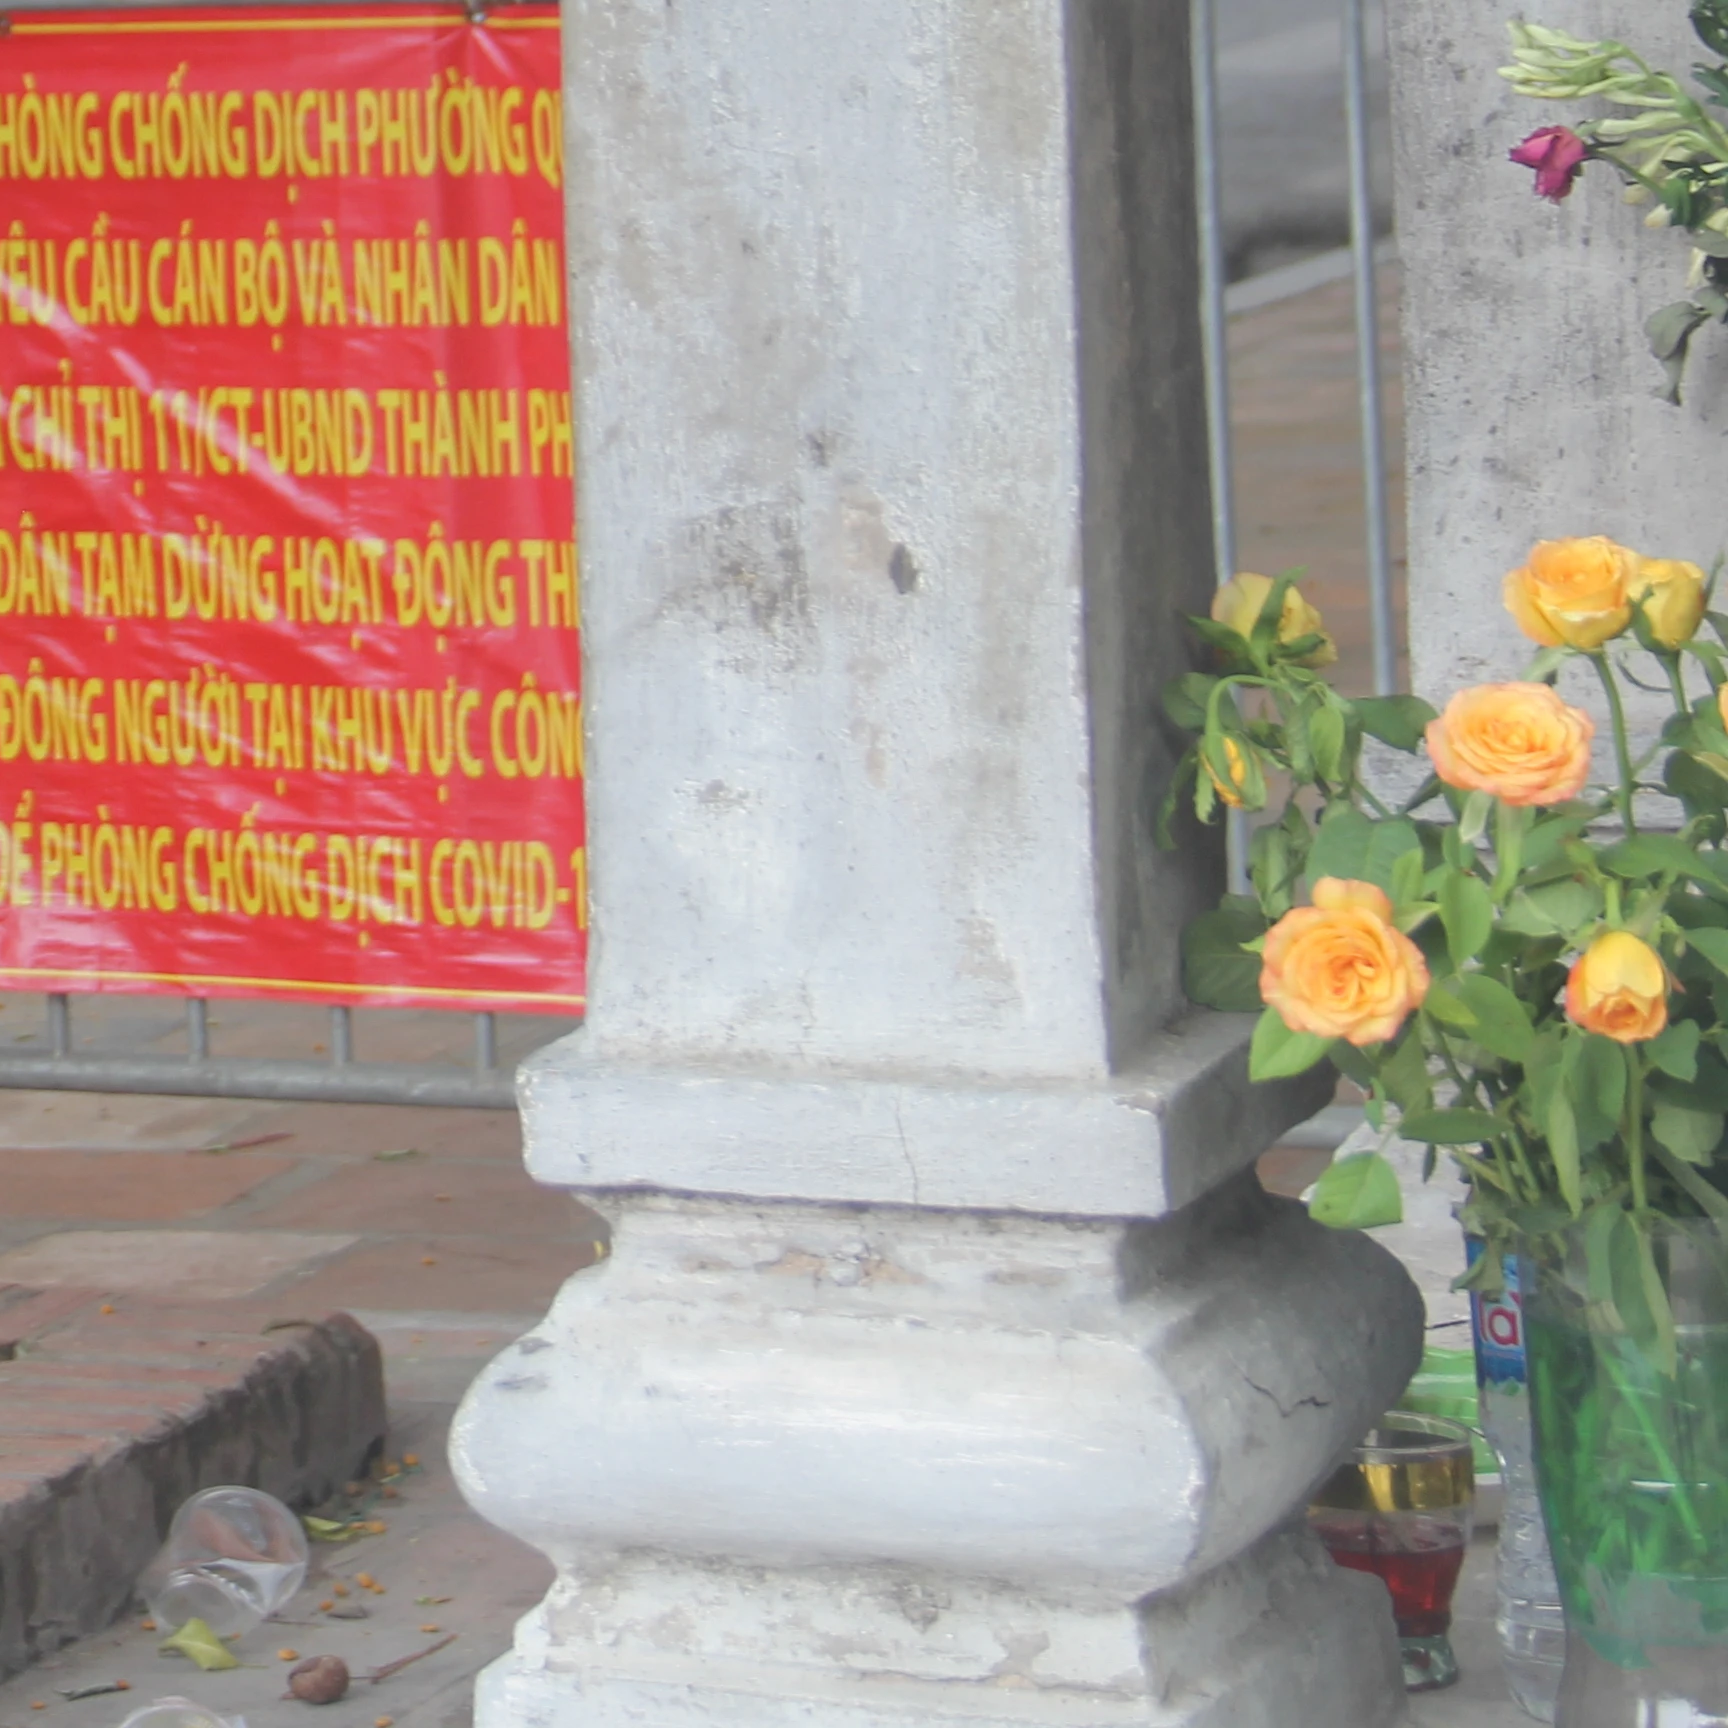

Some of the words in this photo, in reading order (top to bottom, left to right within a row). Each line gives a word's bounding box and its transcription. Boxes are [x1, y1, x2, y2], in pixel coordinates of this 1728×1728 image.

[108, 60, 248, 180] CHỐNG
[253, 88, 350, 205] DỊCH
[355, 66, 529, 178] PHƯỜNG
[63, 210, 142, 327] CẦU
[147, 218, 229, 327] CÁN
[233, 218, 290, 353] BỘ
[291, 218, 347, 328] VÀ
[352, 218, 470, 328] NHÂN
[476, 217, 562, 328] DÂN
[7, 357, 76, 473] CHỈ
[77, 384, 145, 498] THỊ
[148, 384, 374, 478] 11/CT-UBND
[376, 369, 522, 479] THÀNH
[73, 530, 158, 645] TẠM
[161, 513, 279, 624] DỪNG
[282, 534, 388, 652] HOẠT
[391, 520, 517, 655] ĐỘNG
[518, 522, 580, 630] TH
[113, 661, 242, 768] NGƯỜI
[244, 681, 305, 798] TẠI
[308, 684, 392, 776] KHU
[394, 675, 485, 806] VỰC
[489, 670, 584, 780] CÔN
[39, 803, 179, 915] PHÒNG
[182, 800, 321, 921] CHỐNG
[326, 831, 425, 950] DỊCH
